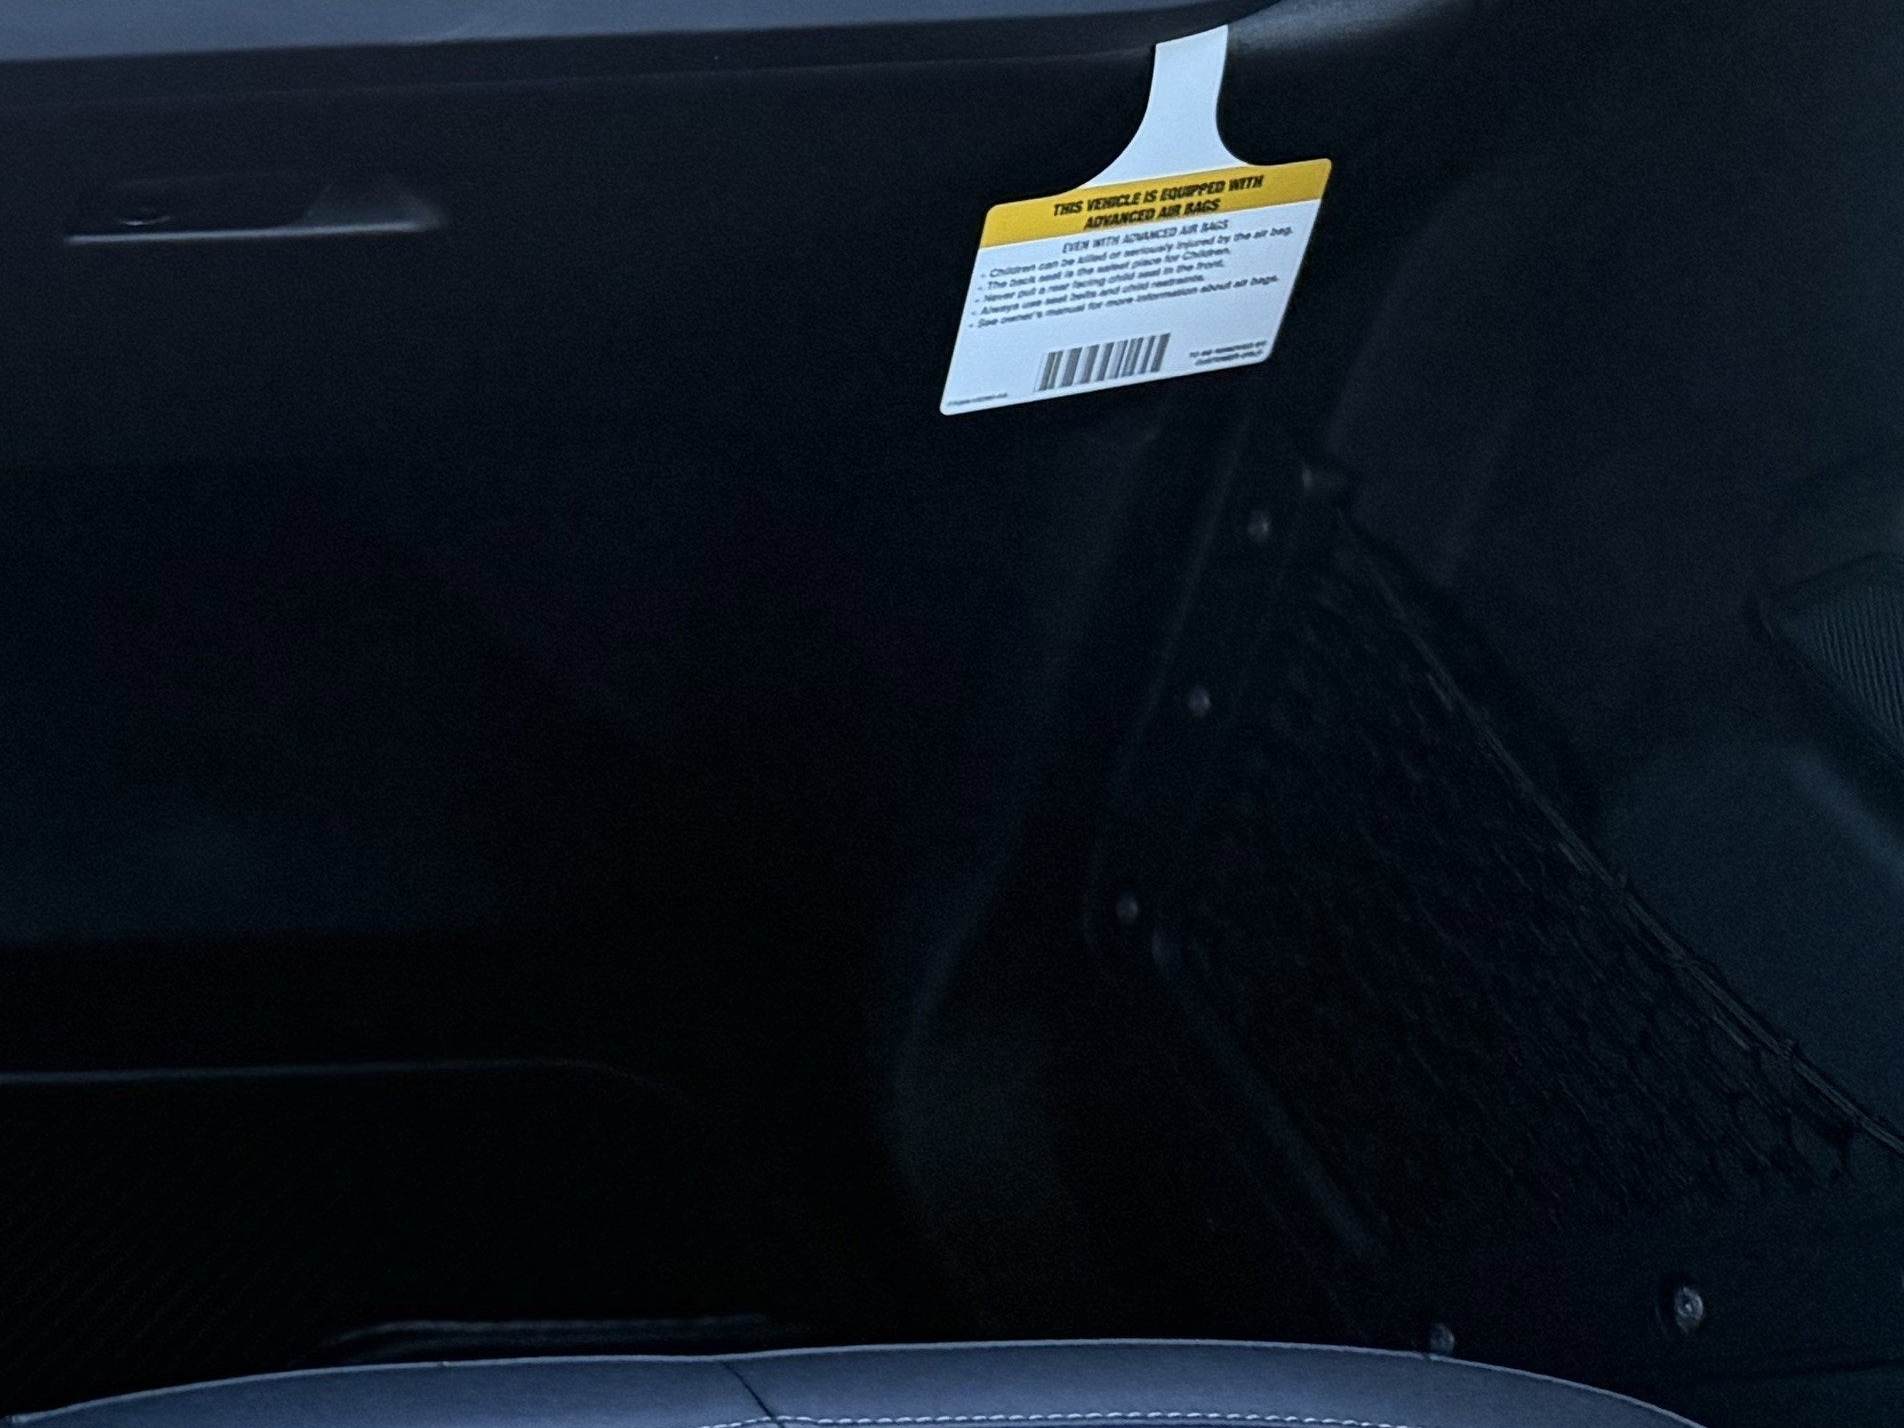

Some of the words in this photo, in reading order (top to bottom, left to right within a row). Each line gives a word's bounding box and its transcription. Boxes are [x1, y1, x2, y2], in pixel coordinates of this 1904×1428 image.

[1053, 200, 1084, 216] THIS
[1087, 192, 1141, 211] VEHICLE
[1143, 189, 1158, 203] IS
[1160, 180, 1226, 201] EQUIPPED
[1228, 175, 1265, 191] WITH
[1083, 206, 1155, 230] ADVANCED
[1155, 202, 1181, 219] AIR
[1183, 198, 1222, 216] BAGS
[1063, 240, 1089, 254] EVEN
[1092, 235, 1120, 249] WITH
[1123, 227, 1177, 244] ADVANCED
